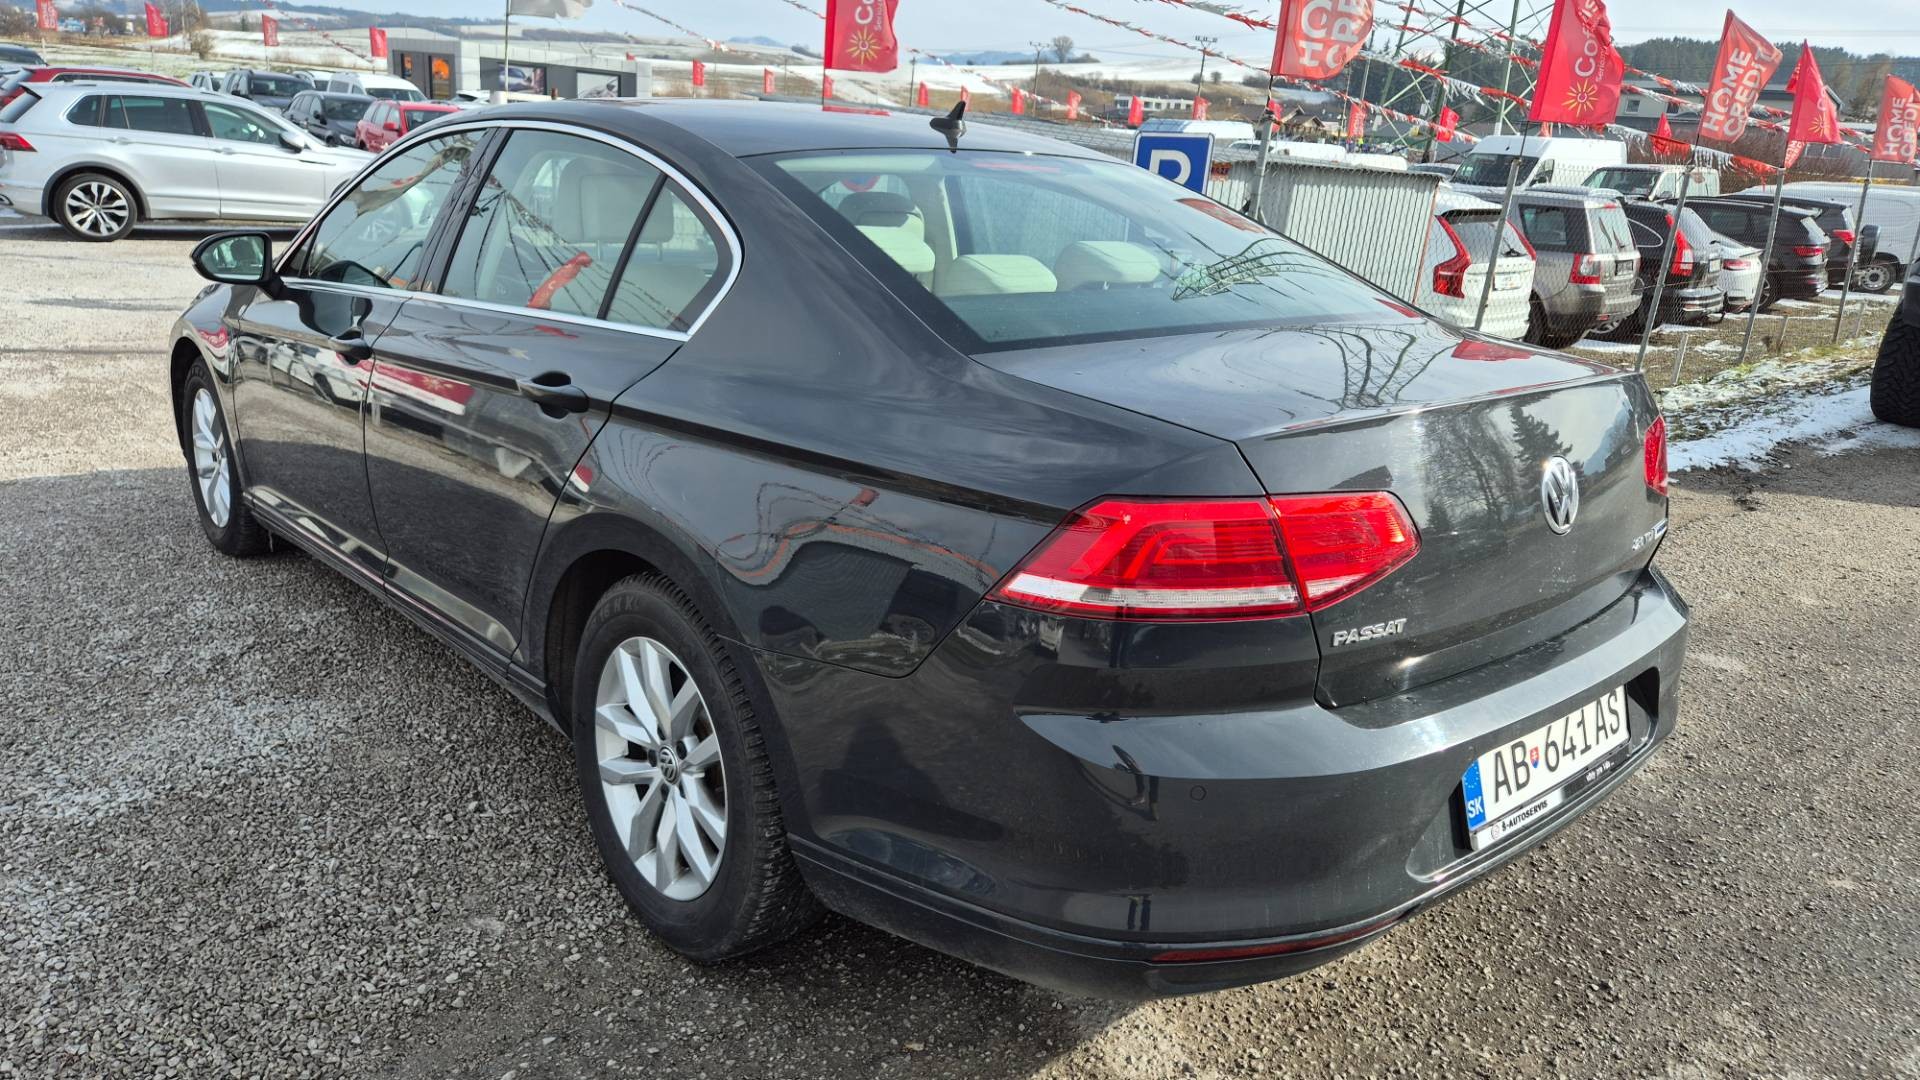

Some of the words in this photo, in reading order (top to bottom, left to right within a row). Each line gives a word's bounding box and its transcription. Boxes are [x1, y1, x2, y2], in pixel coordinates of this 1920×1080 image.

[1702, 48, 1752, 132] HOME
[1883, 96, 1905, 156] HOME
[1149, 149, 1191, 186] P
[1332, 618, 1408, 647] PASSAT
[1494, 740, 1531, 804] AB
[1468, 796, 1483, 818] SK
